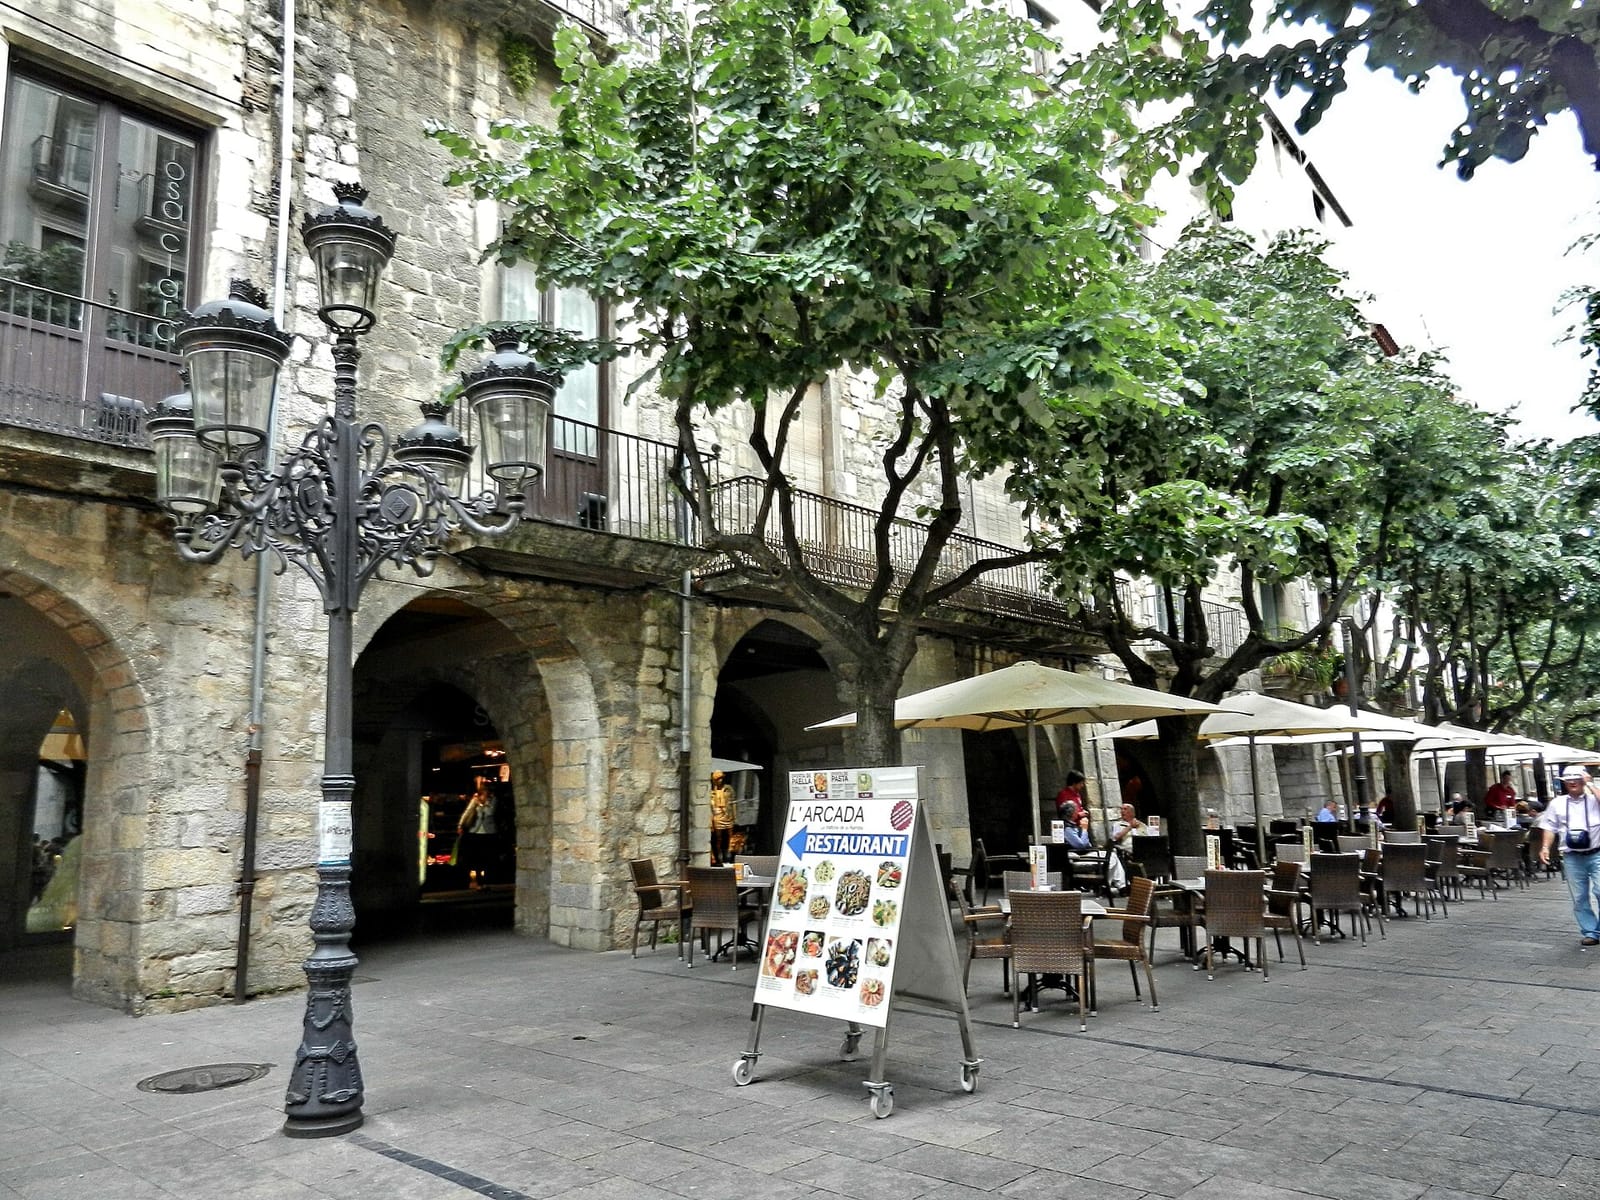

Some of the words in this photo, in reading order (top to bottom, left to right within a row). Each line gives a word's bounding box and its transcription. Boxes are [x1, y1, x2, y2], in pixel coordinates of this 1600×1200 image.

[163, 144, 185, 222] rosa
[831, 775, 849, 783] PASTA
[805, 834, 905, 855] RESTAURANT
